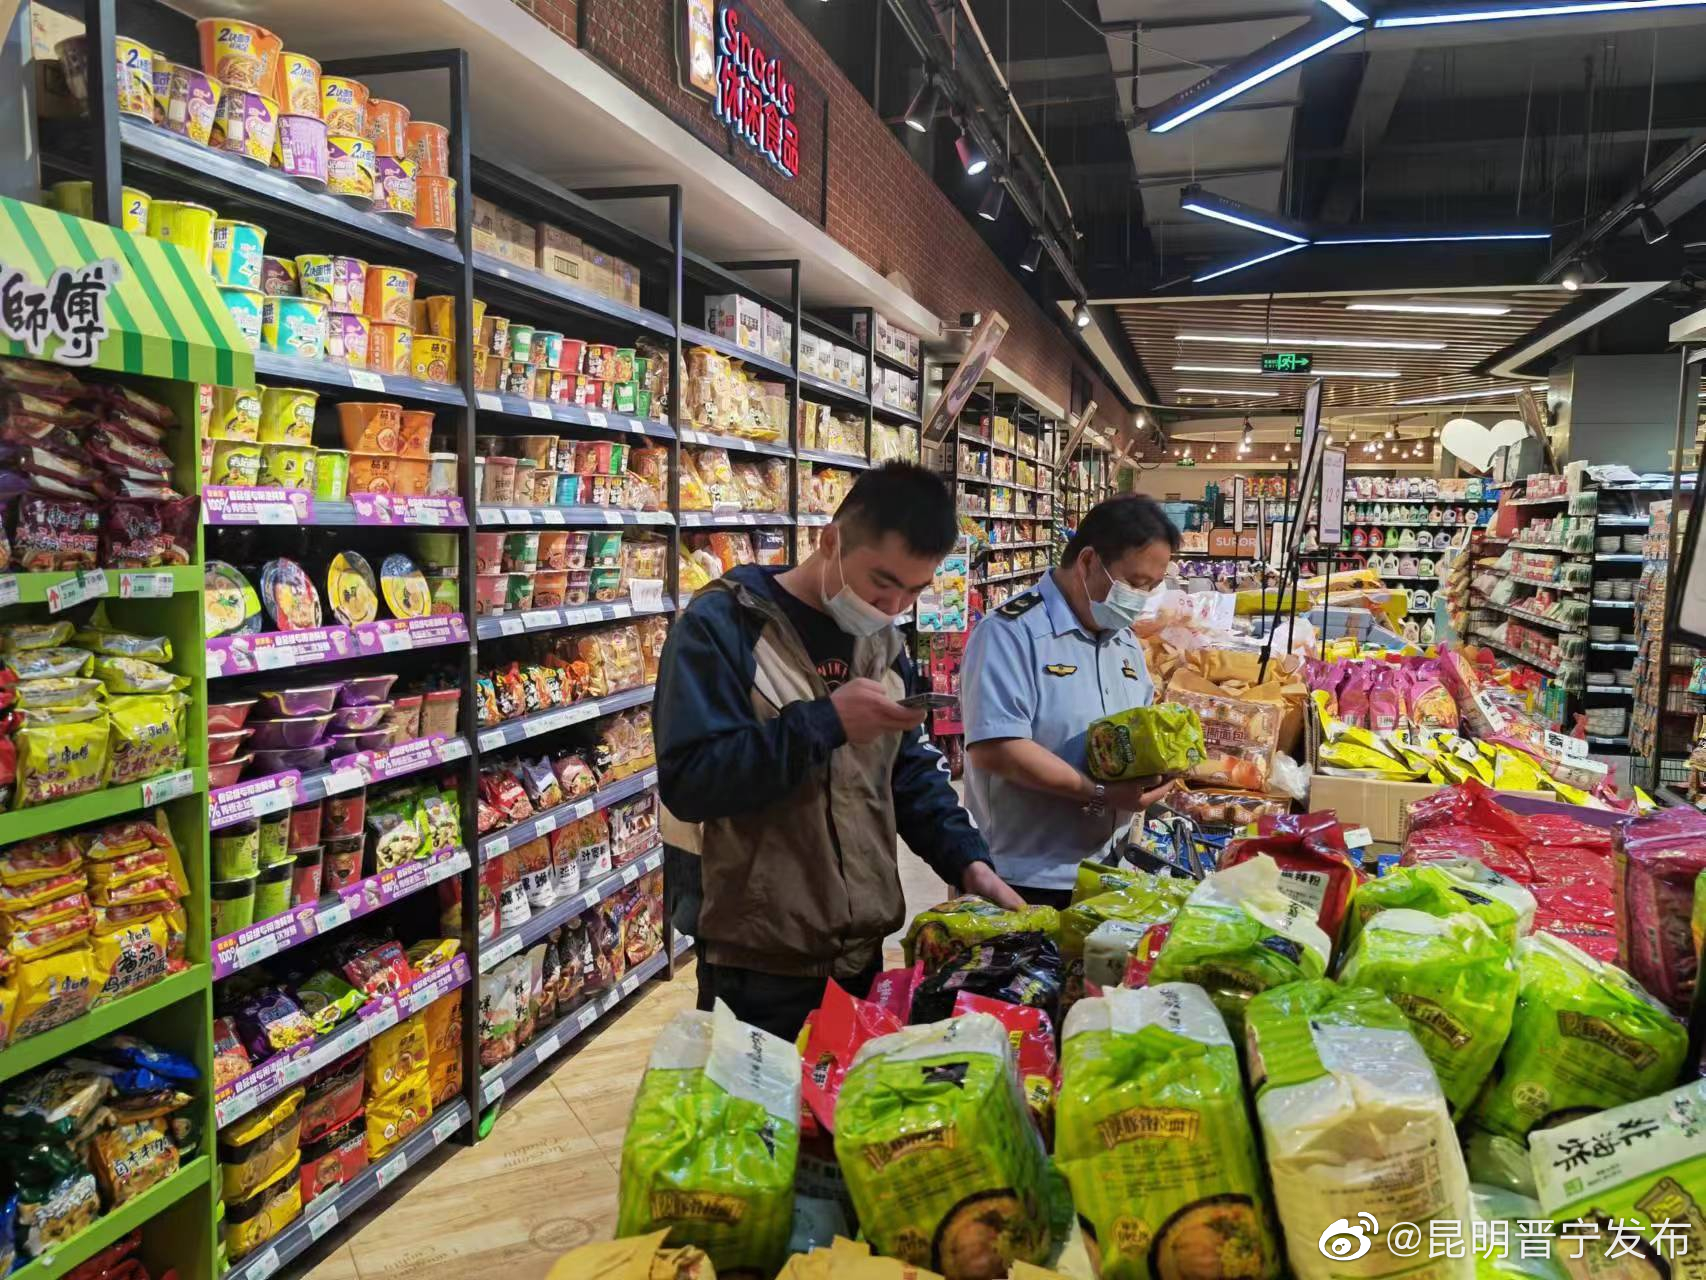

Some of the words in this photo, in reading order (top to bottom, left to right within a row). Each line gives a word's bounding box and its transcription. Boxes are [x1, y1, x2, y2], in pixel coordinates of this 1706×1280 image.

[722, 8, 796, 114] Snacks
[716, 56, 799, 178] 休闲食品
[0, 265, 106, 359] 師傅
[118, 945, 156, 973] 番茄
